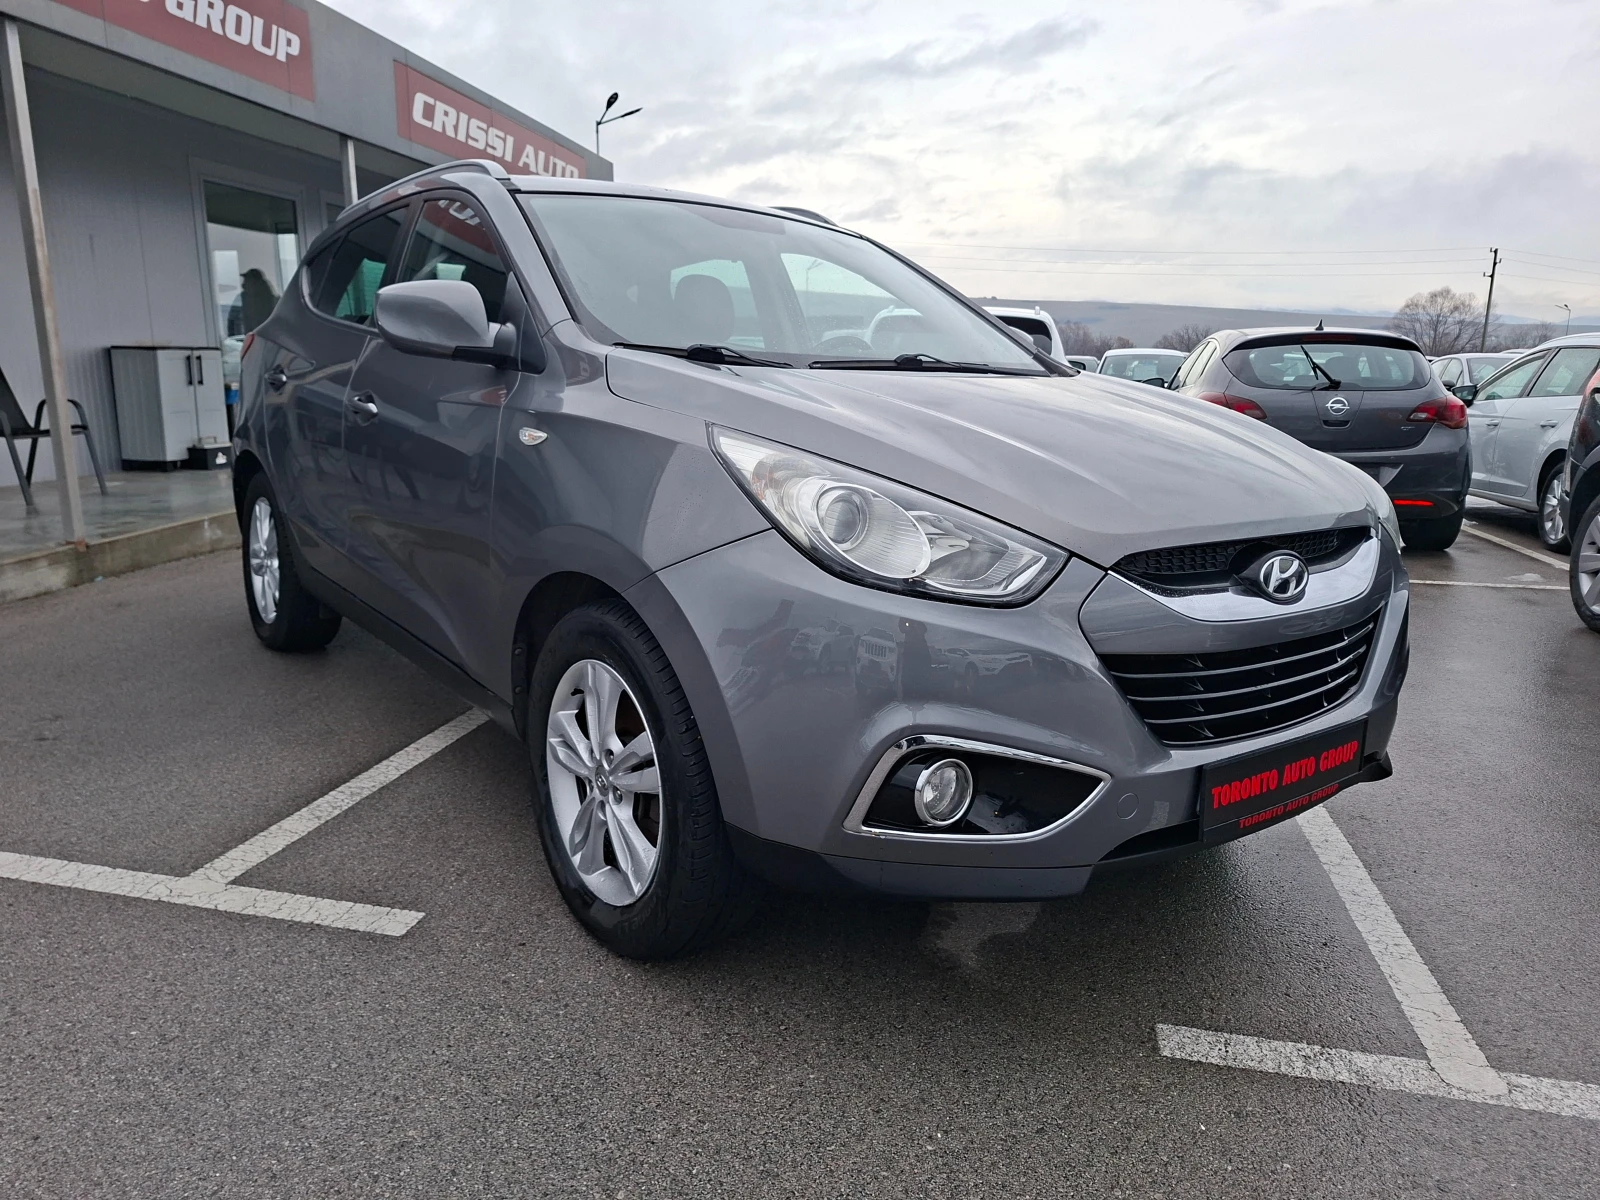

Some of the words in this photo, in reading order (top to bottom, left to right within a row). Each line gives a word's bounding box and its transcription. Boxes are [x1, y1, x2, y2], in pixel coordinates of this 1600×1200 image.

[165, 0, 300, 62] GROUP
[413, 92, 514, 162] CRISSI
[1212, 769, 1278, 809] TORONTO
[1282, 757, 1316, 786] AUTO
[1319, 740, 1358, 772] GROUP
[1239, 806, 1284, 829] TORONTO
[1286, 796, 1309, 811] AUTO
[1311, 783, 1339, 802] GROUP
